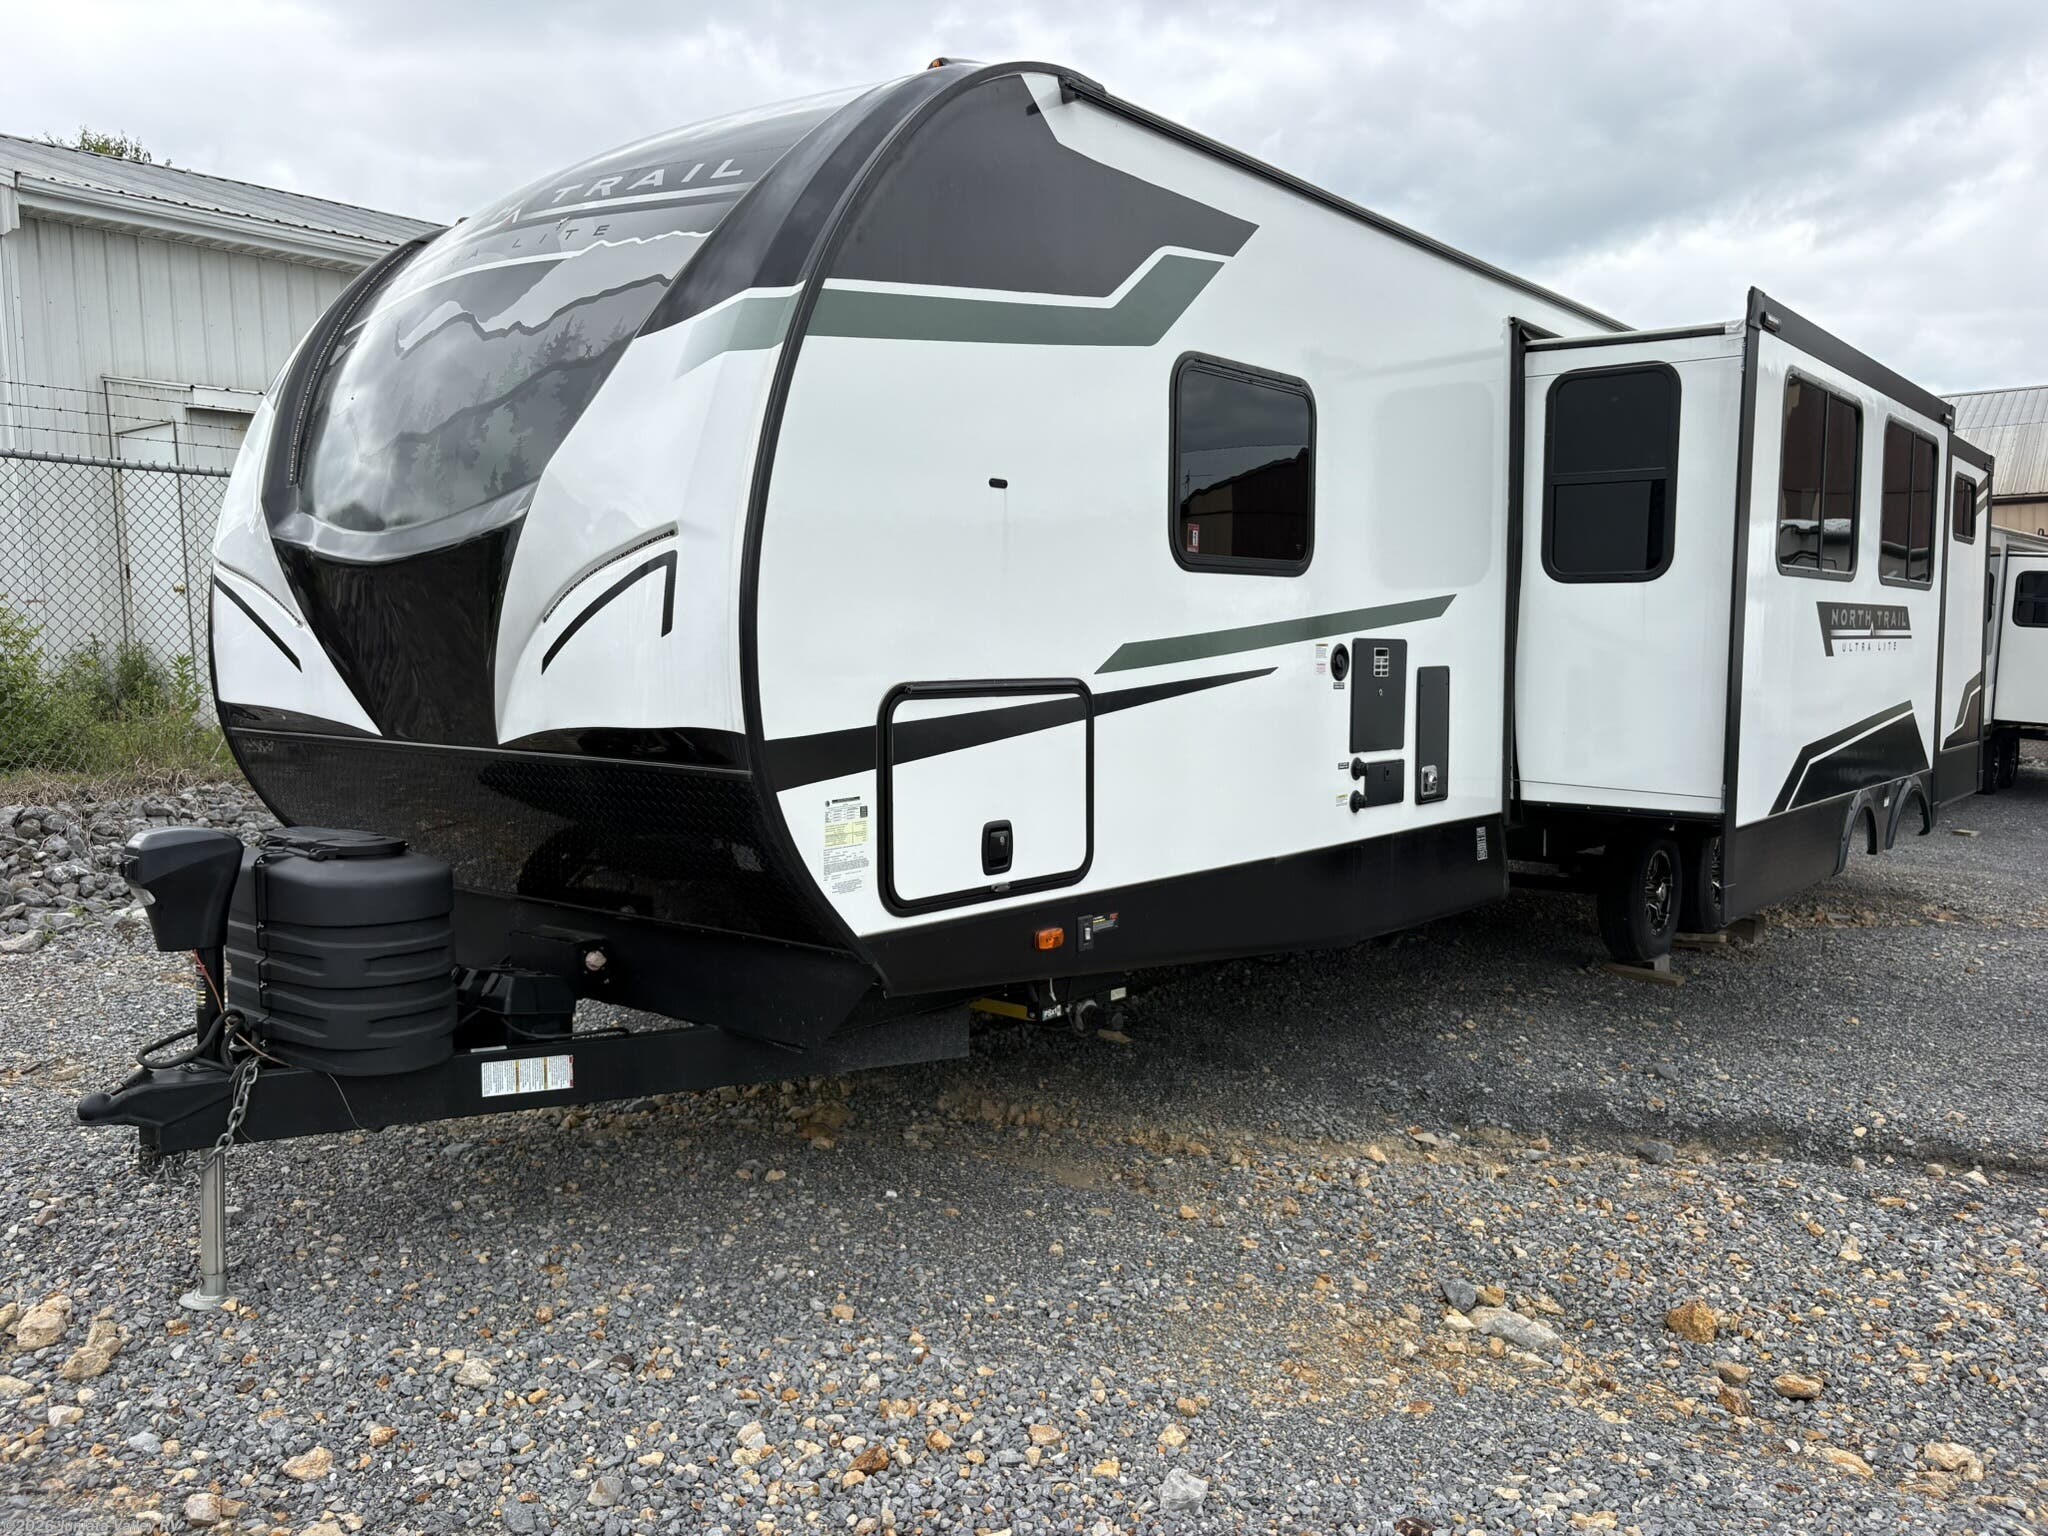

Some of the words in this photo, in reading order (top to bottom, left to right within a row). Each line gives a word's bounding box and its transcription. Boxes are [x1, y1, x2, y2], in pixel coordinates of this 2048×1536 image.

[552, 159, 743, 203] TRAIL
[511, 224, 610, 249] LITE
[1831, 608, 1872, 627] NORTH
[1877, 610, 1906, 628] TRAIL
[1841, 641, 1872, 653] ULTRA
[1877, 641, 1898, 652] LITE
